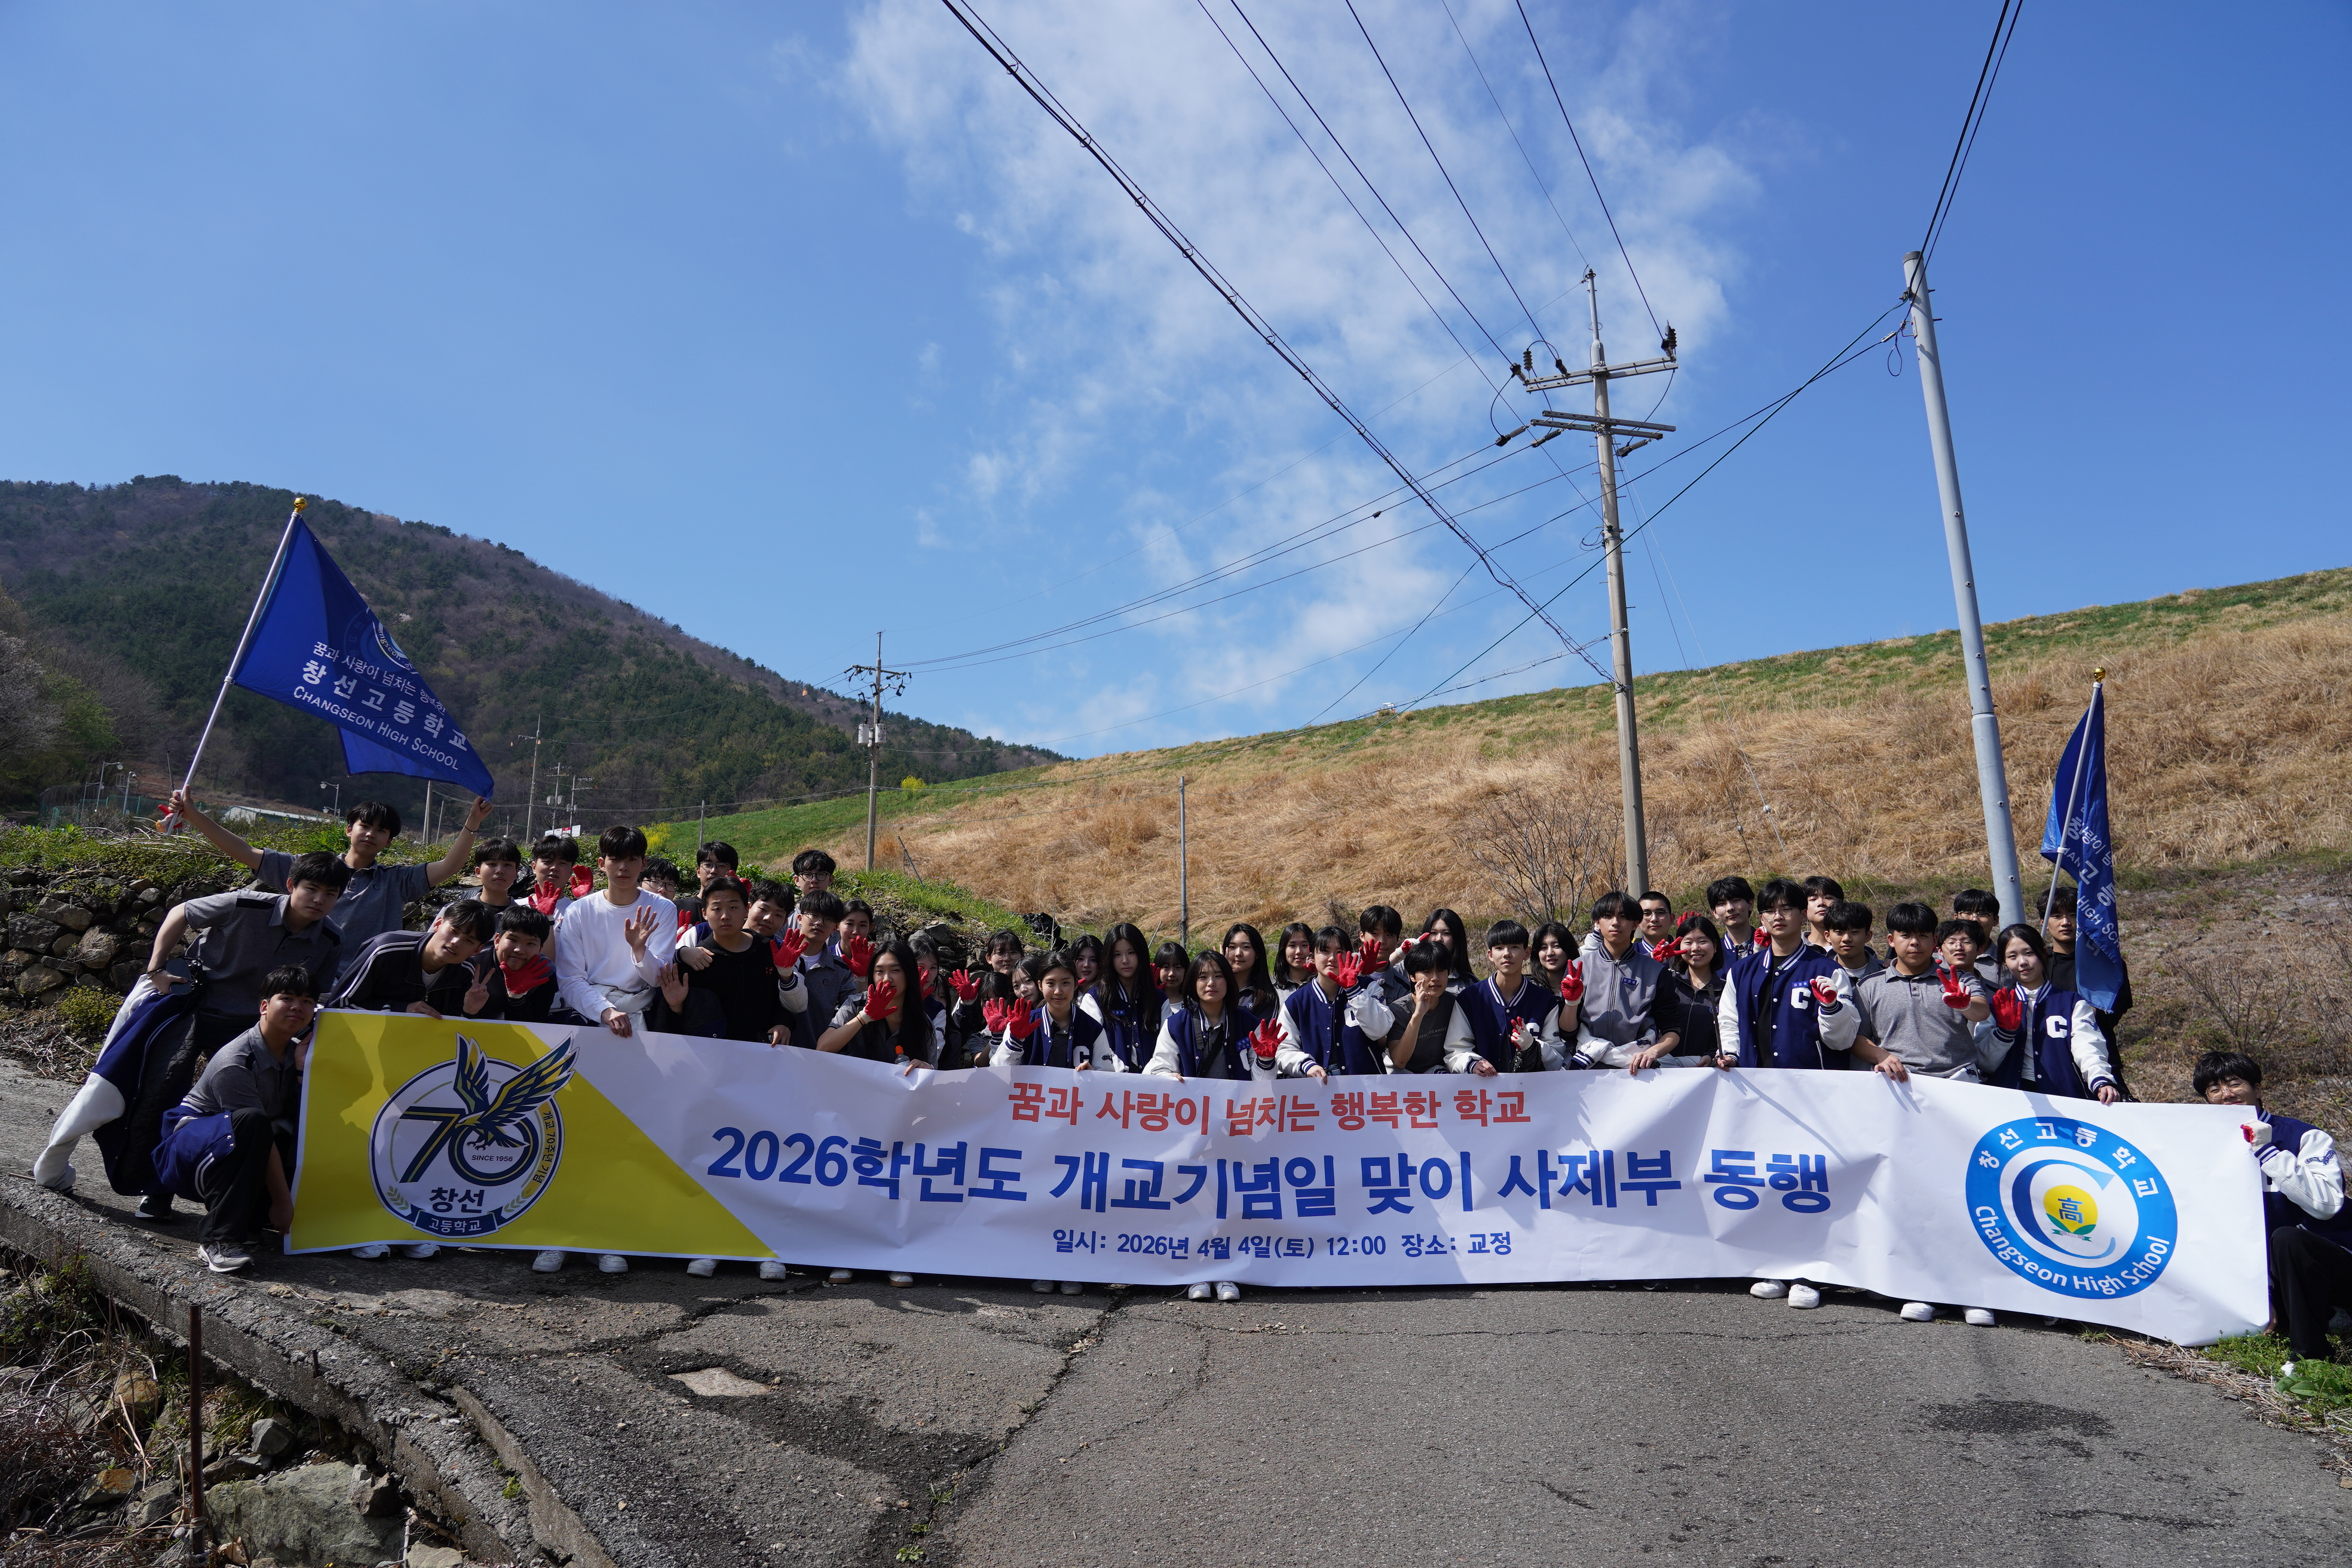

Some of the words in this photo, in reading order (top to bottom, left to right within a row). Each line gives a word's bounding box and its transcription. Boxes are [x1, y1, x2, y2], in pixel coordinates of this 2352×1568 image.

[313, 641, 339, 663] 꿈과
[341, 656, 379, 680] 사랑이
[382, 671, 416, 696] 넘치는
[293, 685, 374, 730] CHANGSEON
[378, 721, 409, 745] HIGH
[412, 737, 459, 771] SCHOOL
[1791, 987, 1811, 1009] C
[2046, 1015, 2068, 1038] C
[1073, 1046, 1090, 1067] C
[543, 1111, 555, 1130] 개교
[1009, 1082, 1084, 1126] 꿈과
[1095, 1089, 1209, 1135] 사랑이
[1226, 1094, 1320, 1137] 넘치는
[1330, 1091, 1441, 1132] 행복한
[1453, 1089, 1532, 1127] 학교
[542, 1132, 555, 1162] 70주년
[532, 1166, 549, 1183] 기념
[706, 1126, 1028, 1203] 2026학년도
[1049, 1151, 1336, 1221] 개교기념일
[1361, 1150, 1474, 1215] 맞이
[1497, 1149, 1682, 1210] 사제부
[1703, 1149, 1831, 1214] 동행
[429, 1187, 485, 1214] 창선
[2057, 1197, 2083, 1224] 高
[428, 1217, 482, 1233] 고등학교
[1052, 1229, 1107, 1254] 일시:
[1116, 1233, 1189, 1260] 2026년
[1197, 1238, 1230, 1260] 4월
[1238, 1235, 1315, 1259] 4일(토)
[1327, 1235, 1386, 1255] 12:00
[1401, 1233, 1456, 1258] 장소:
[1468, 1231, 1512, 1255] 교정
[1976, 1205, 2068, 1288] Changseon
[2074, 1276, 2126, 1296] High
[2121, 1236, 2171, 1287] School
